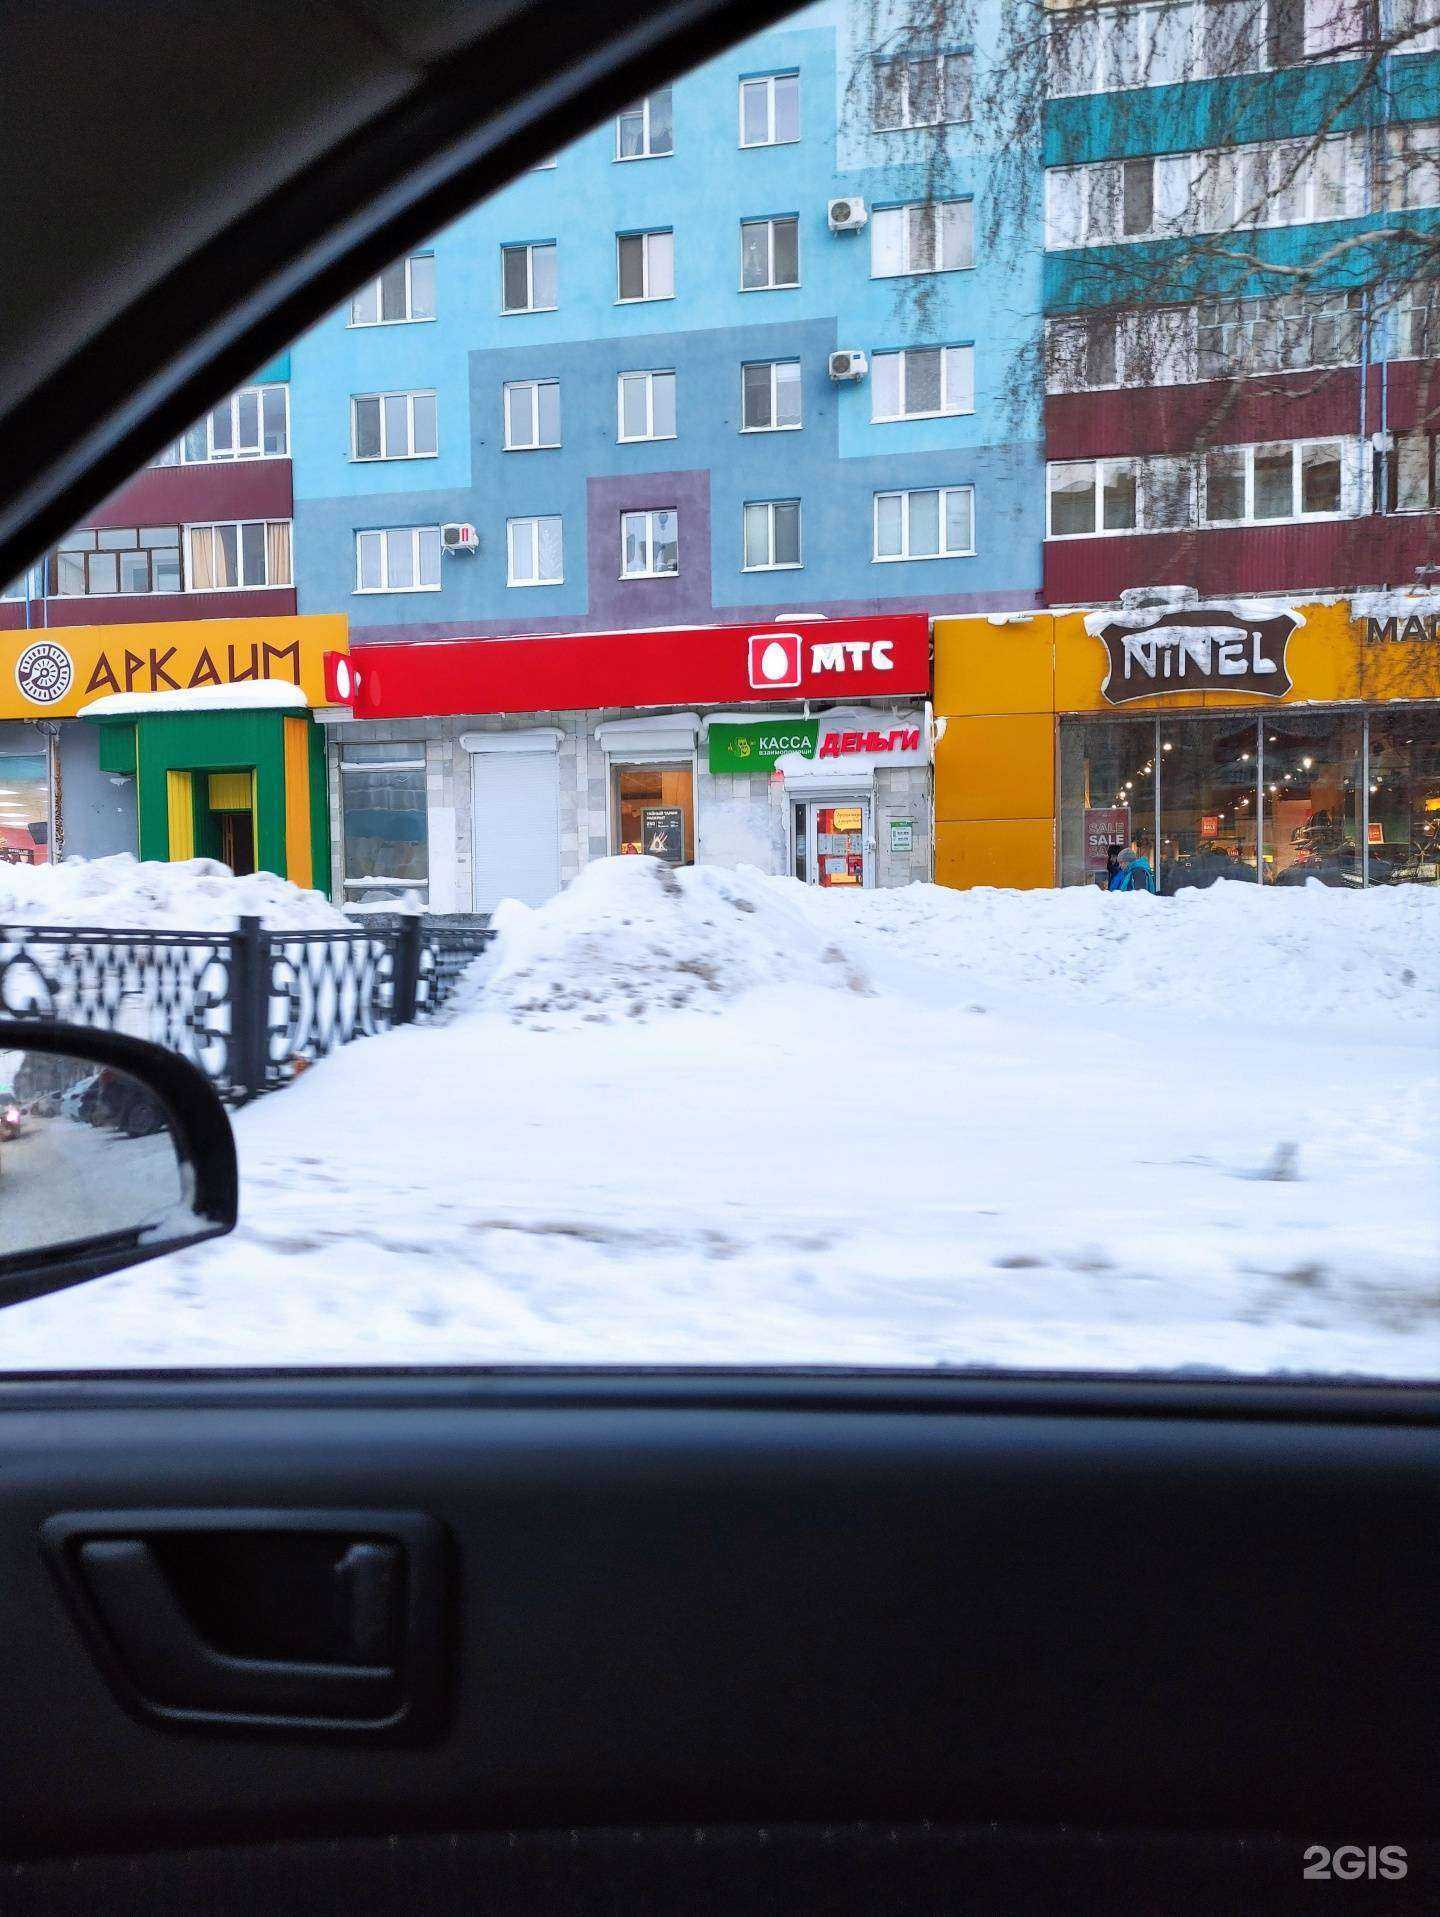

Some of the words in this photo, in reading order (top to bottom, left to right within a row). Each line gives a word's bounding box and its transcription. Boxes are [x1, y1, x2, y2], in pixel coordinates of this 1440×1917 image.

[84, 640, 301, 695] АРКАИМ
[811, 641, 894, 673] МТС
[759, 736, 812, 749] КАССА
[819, 730, 920, 759] ДЕНЬГИ
[1089, 822, 1124, 834] SALE
[1089, 834, 1124, 845] SALE
